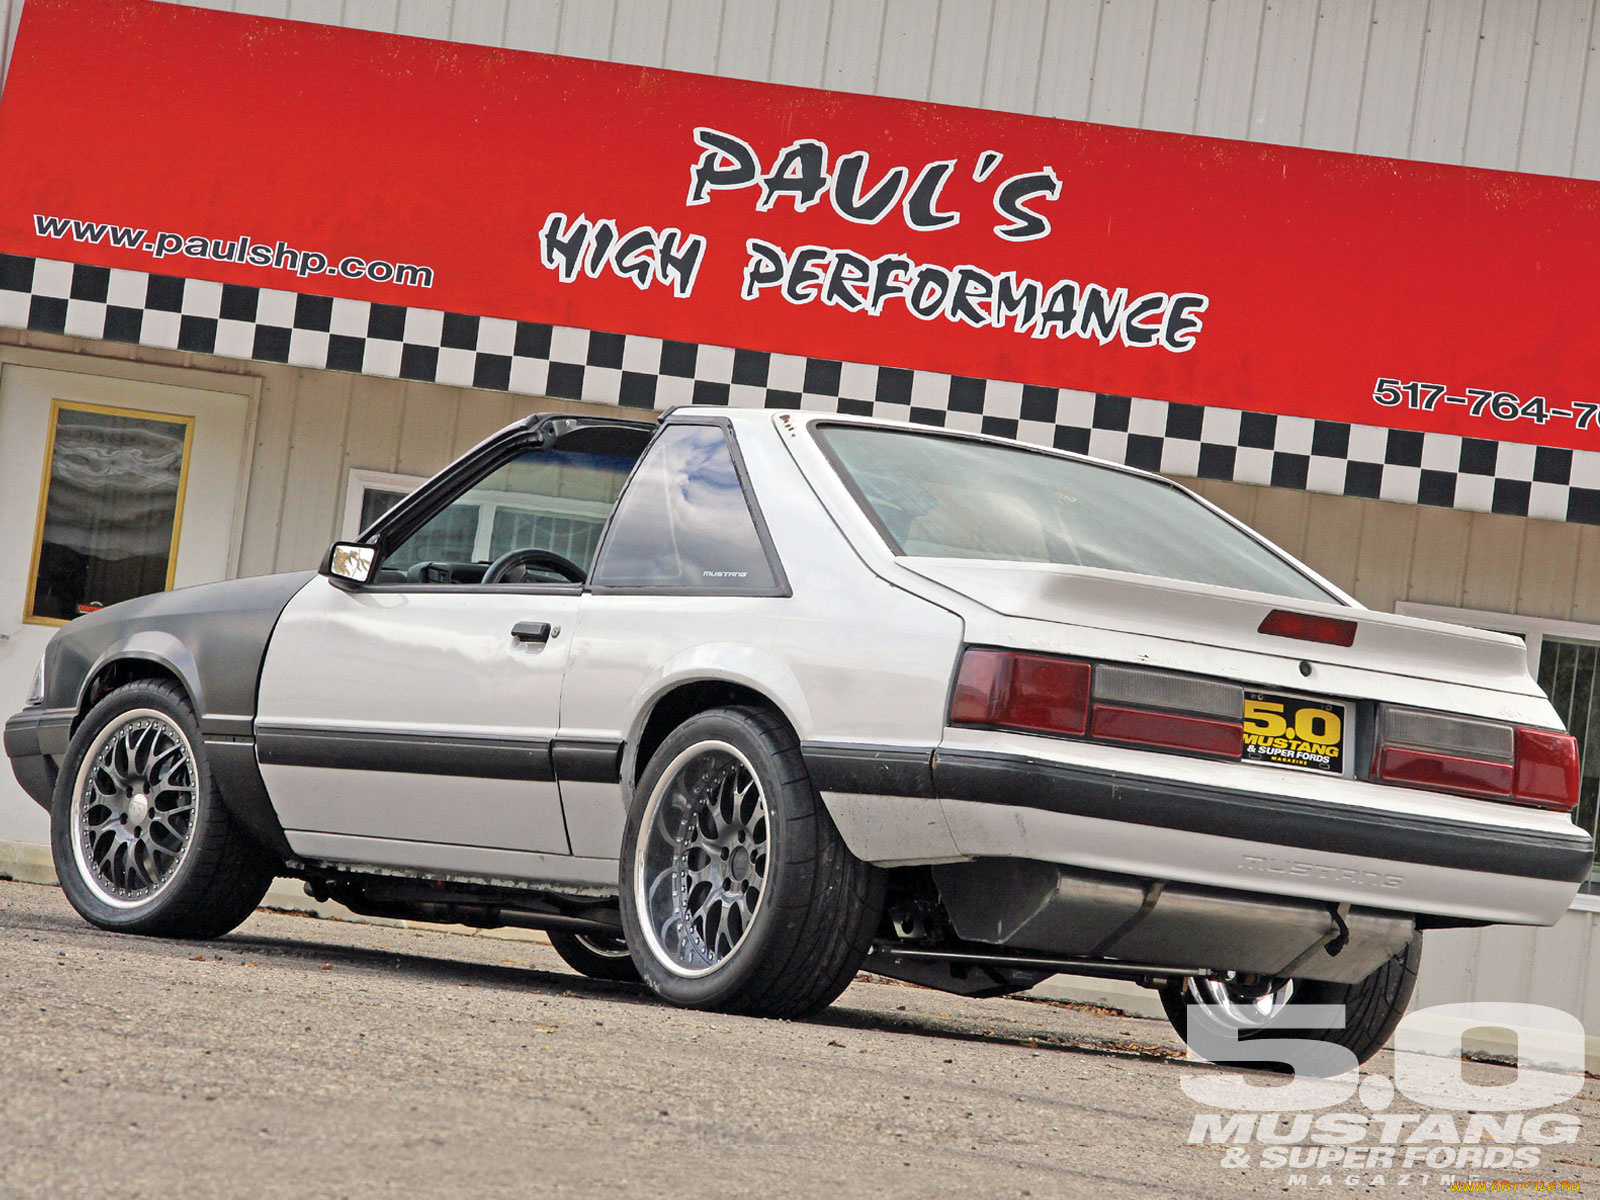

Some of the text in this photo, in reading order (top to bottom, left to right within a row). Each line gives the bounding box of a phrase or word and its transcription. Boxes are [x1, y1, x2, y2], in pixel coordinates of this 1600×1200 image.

[686, 127, 1064, 242] PAUL'S
[33, 213, 434, 289] www.paulshp.com
[539, 212, 1209, 352] HIGH PERFORMANCE
[1372, 377, 1600, 430] 517-764-7
[1243, 699, 1341, 746] 5.0
[1243, 733, 1339, 758] MUSTANG
[1246, 744, 1331, 764] & SUPER FORDS
[1271, 755, 1308, 766] MAGAZINE
